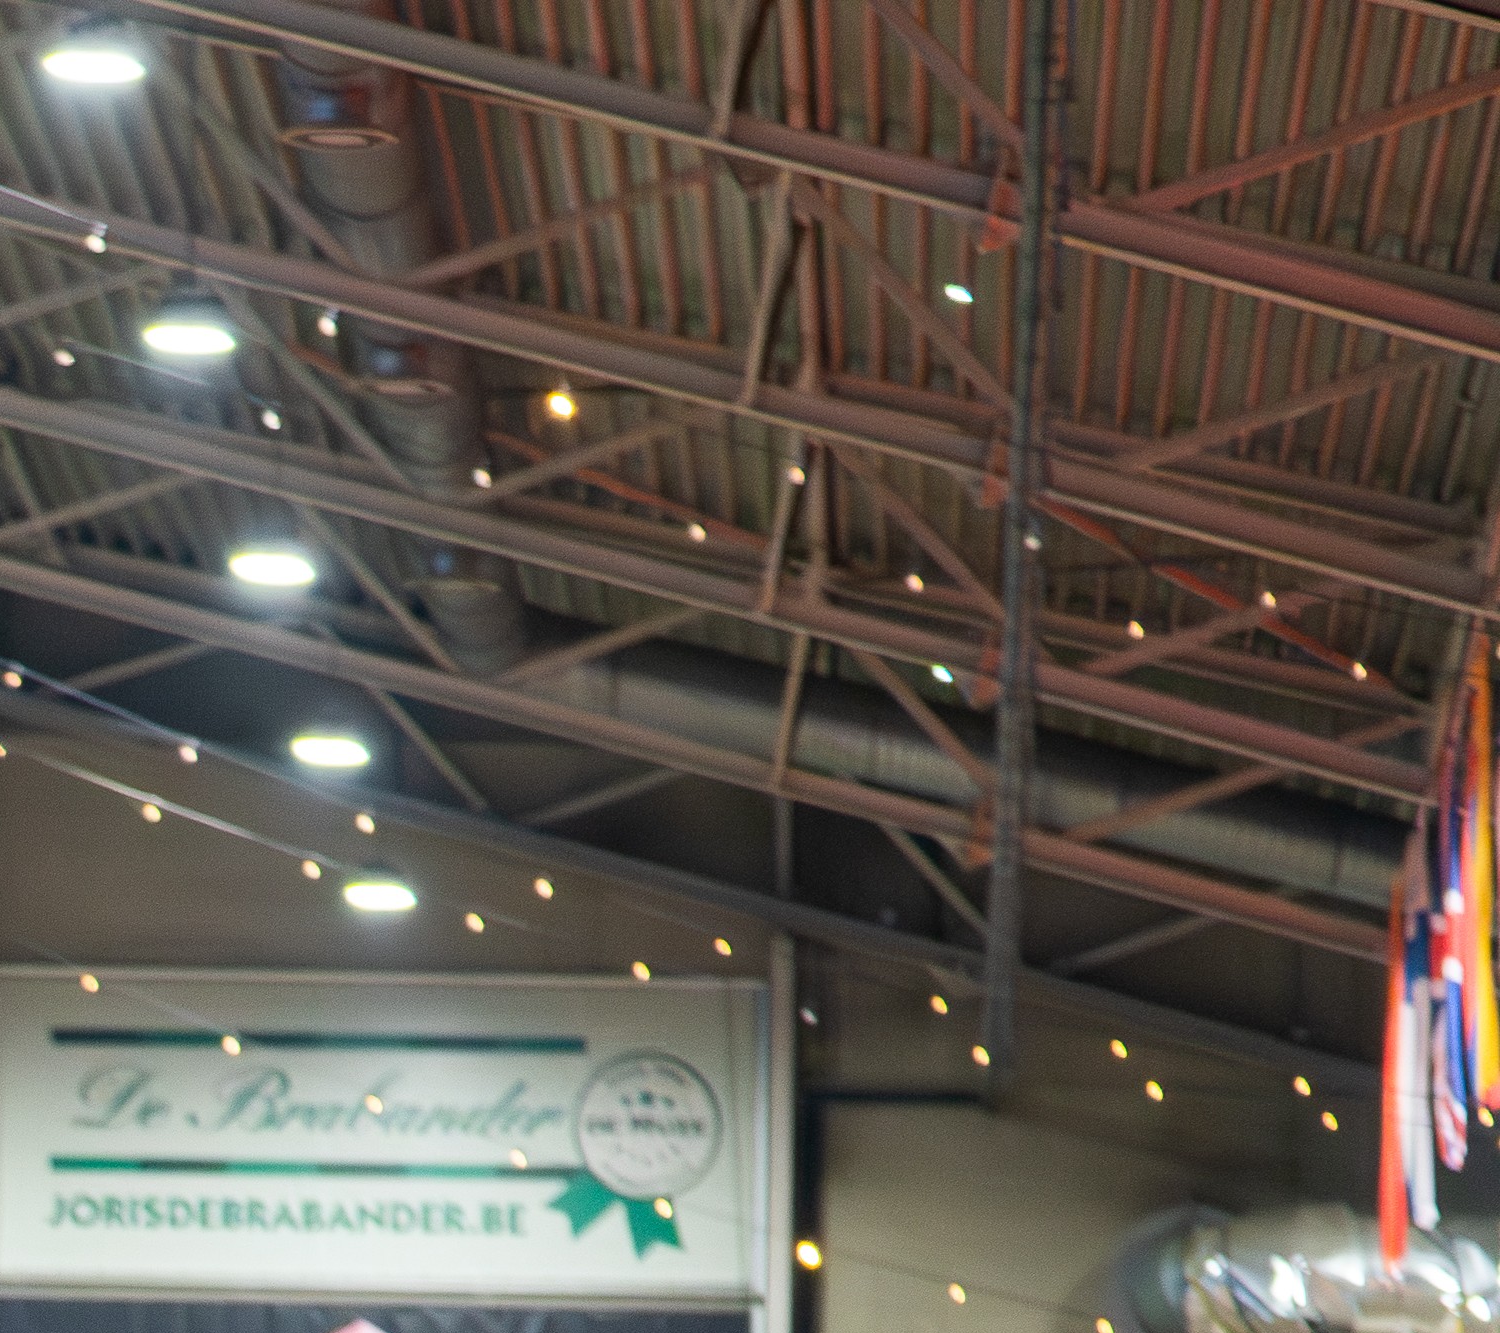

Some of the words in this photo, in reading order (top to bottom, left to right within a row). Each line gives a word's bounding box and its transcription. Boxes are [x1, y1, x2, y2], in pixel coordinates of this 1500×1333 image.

[70, 1064, 173, 1129] De
[185, 1064, 569, 1139] Brabander
[46, 1192, 529, 1238] JORISDEBRABANDER.BE
